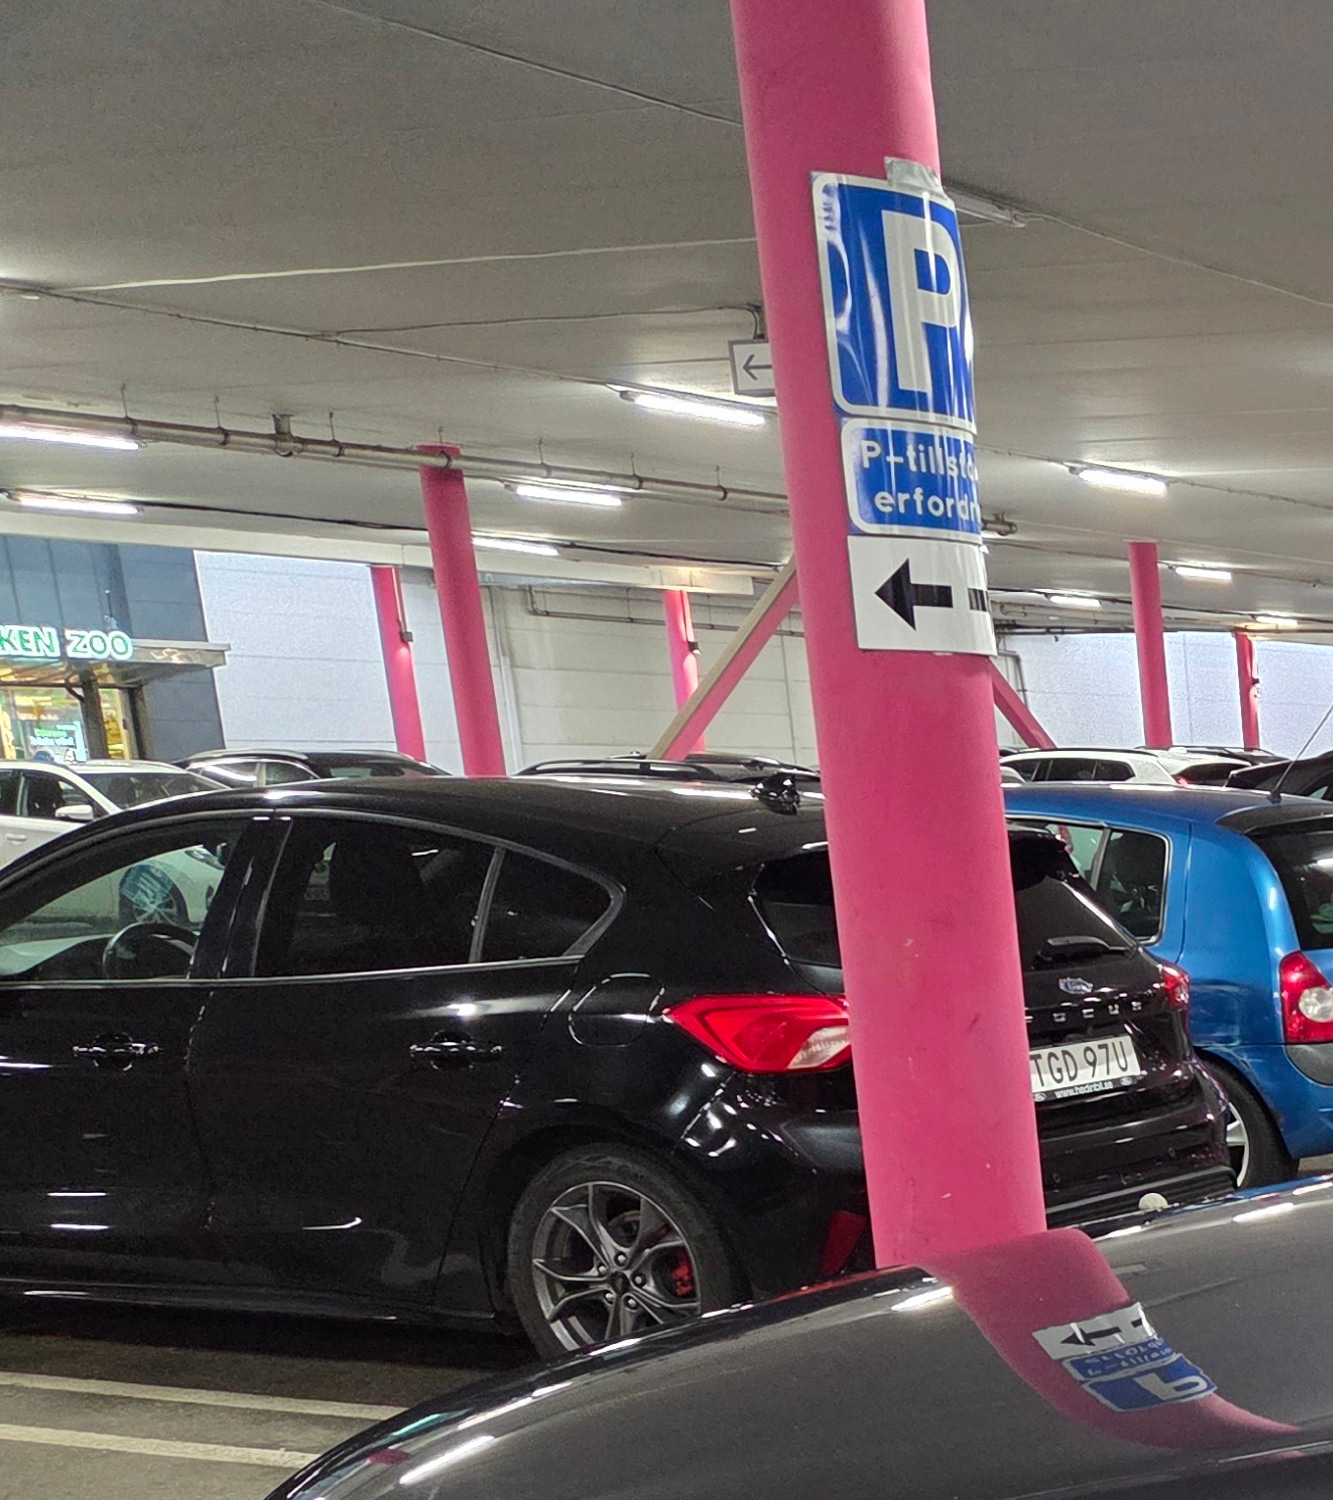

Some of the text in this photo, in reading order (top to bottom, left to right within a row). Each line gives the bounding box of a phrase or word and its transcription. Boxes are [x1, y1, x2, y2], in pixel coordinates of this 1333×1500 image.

[881, 209, 961, 393] P
[66, 629, 132, 660] ZOO
[1029, 1040, 1128, 1087] TGD 97U
